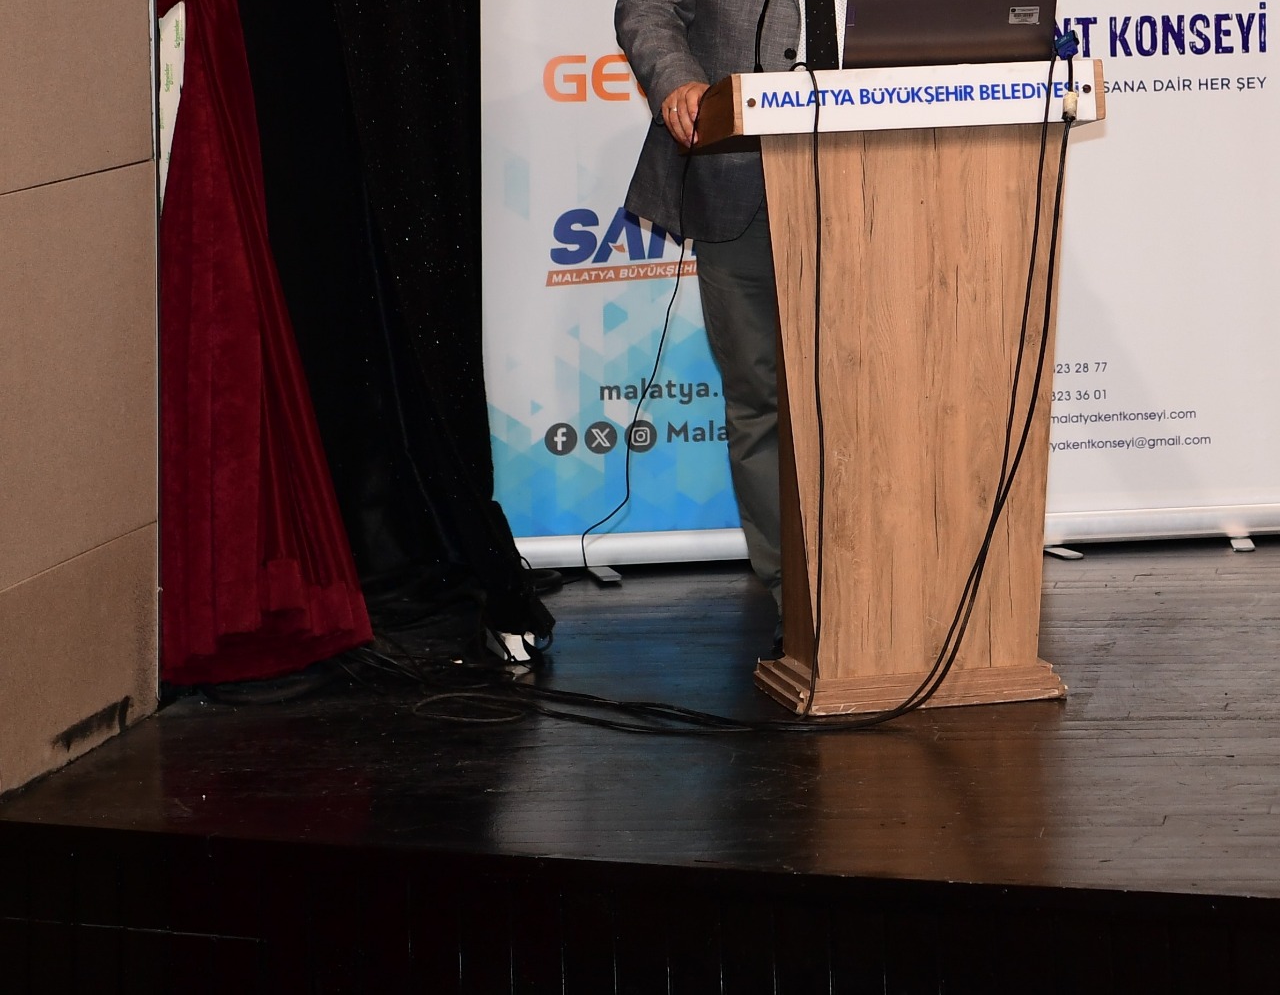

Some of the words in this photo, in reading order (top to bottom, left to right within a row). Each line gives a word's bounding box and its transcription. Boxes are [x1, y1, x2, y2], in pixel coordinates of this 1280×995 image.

[1109, 1, 1267, 57] KONSEYİ
[542, 54, 648, 103] GE
[1154, 76, 1192, 92] DAİR
[1198, 78, 1231, 91] HER
[1237, 76, 1267, 91] ŞEY
[761, 88, 855, 109] MALATYA
[859, 85, 974, 106] BÜYÜKŞEHİR
[552, 269, 615, 283] MALATYA
[1053, 363, 1071, 374] 23
[1074, 363, 1089, 373] 28
[1094, 362, 1108, 373] 77
[1075, 390, 1090, 401] 36
[1093, 389, 1107, 400] 01
[1050, 435, 1211, 452] yakentkonseyi@gmail.com
